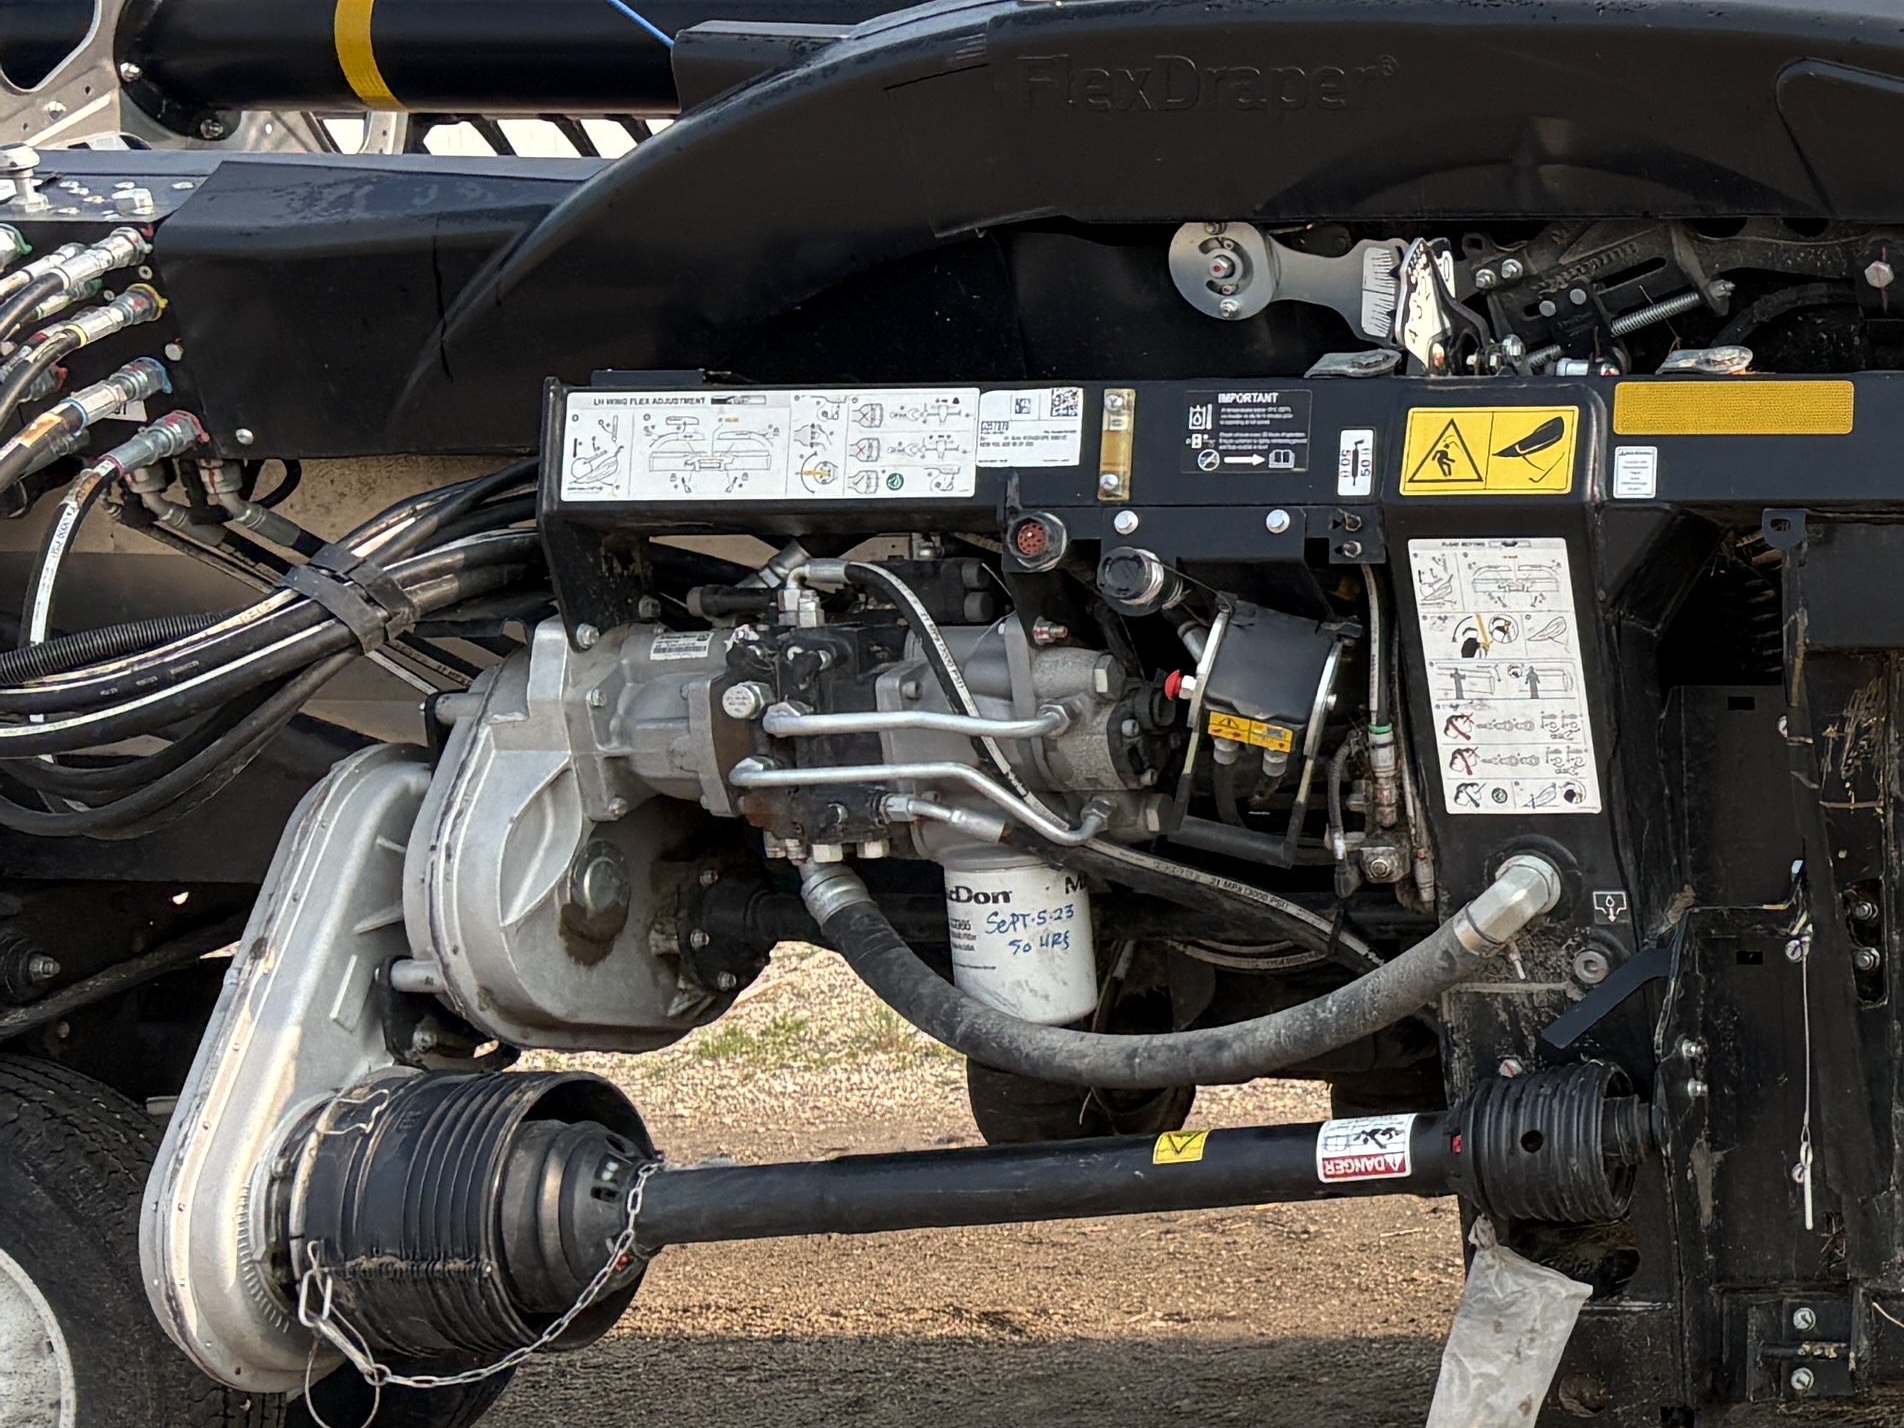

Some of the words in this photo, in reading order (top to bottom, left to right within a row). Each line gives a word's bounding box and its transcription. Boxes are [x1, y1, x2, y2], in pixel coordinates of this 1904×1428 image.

[630, 398, 650, 406] FLEX
[651, 397, 706, 405] ADJUSTMENT
[1218, 392, 1279, 404] IMPORTANT
[1325, 1158, 1385, 1175] DANGER
